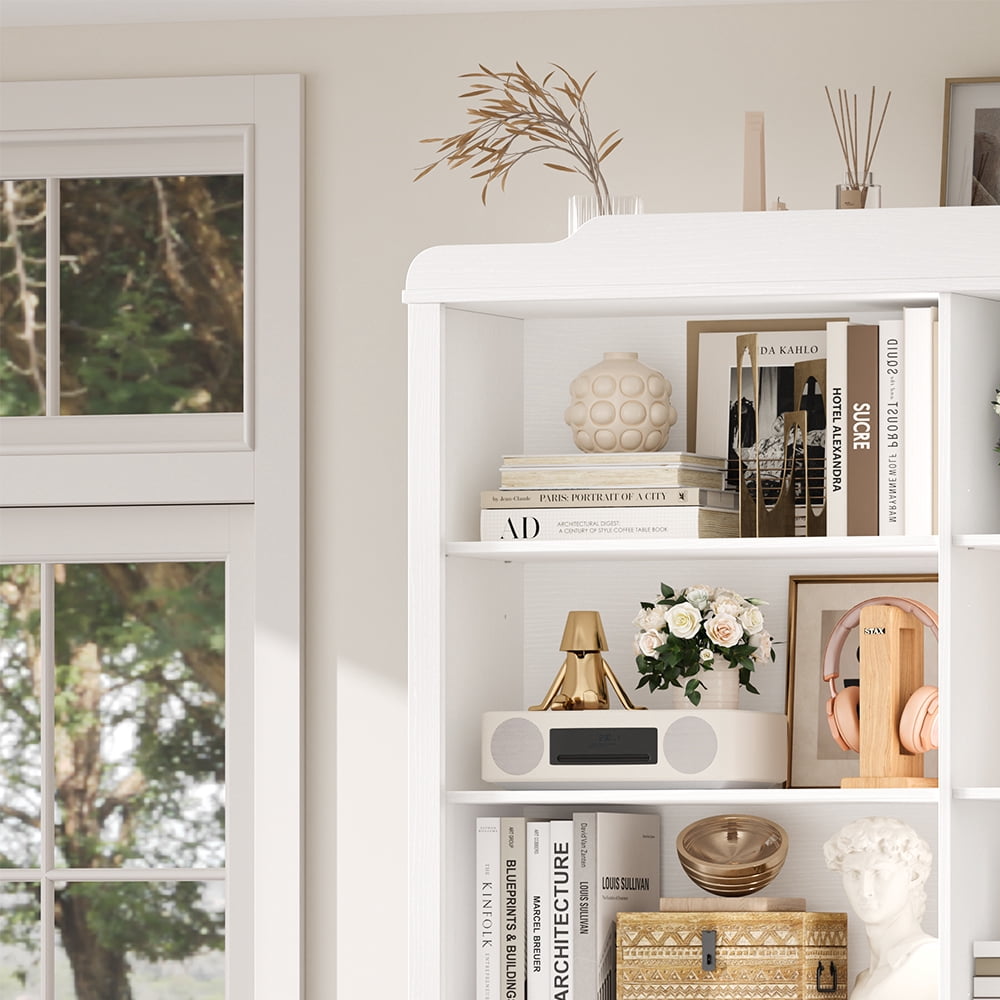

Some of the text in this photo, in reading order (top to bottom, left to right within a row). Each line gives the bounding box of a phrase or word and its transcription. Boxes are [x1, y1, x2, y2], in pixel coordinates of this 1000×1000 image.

[780, 345, 818, 354] KAHLO
[832, 388, 842, 492] HOTEL ALEXANDRA
[853, 402, 870, 449] SUCRE
[540, 494, 568, 502] PARIS:
[572, 493, 618, 502] PORTRAIT
[645, 492, 666, 500] CITY
[500, 517, 540, 539] AD
[506, 860, 516, 930] BLUEPRINTS
[602, 877, 649, 890] LOUIS SULLIVAN
[482, 882, 492, 948] KINFOLK
[580, 881, 589, 934] LOUIS SULLIVAN
[506, 934, 516, 942] &
[533, 896, 541, 972] MARCEL BREUER
